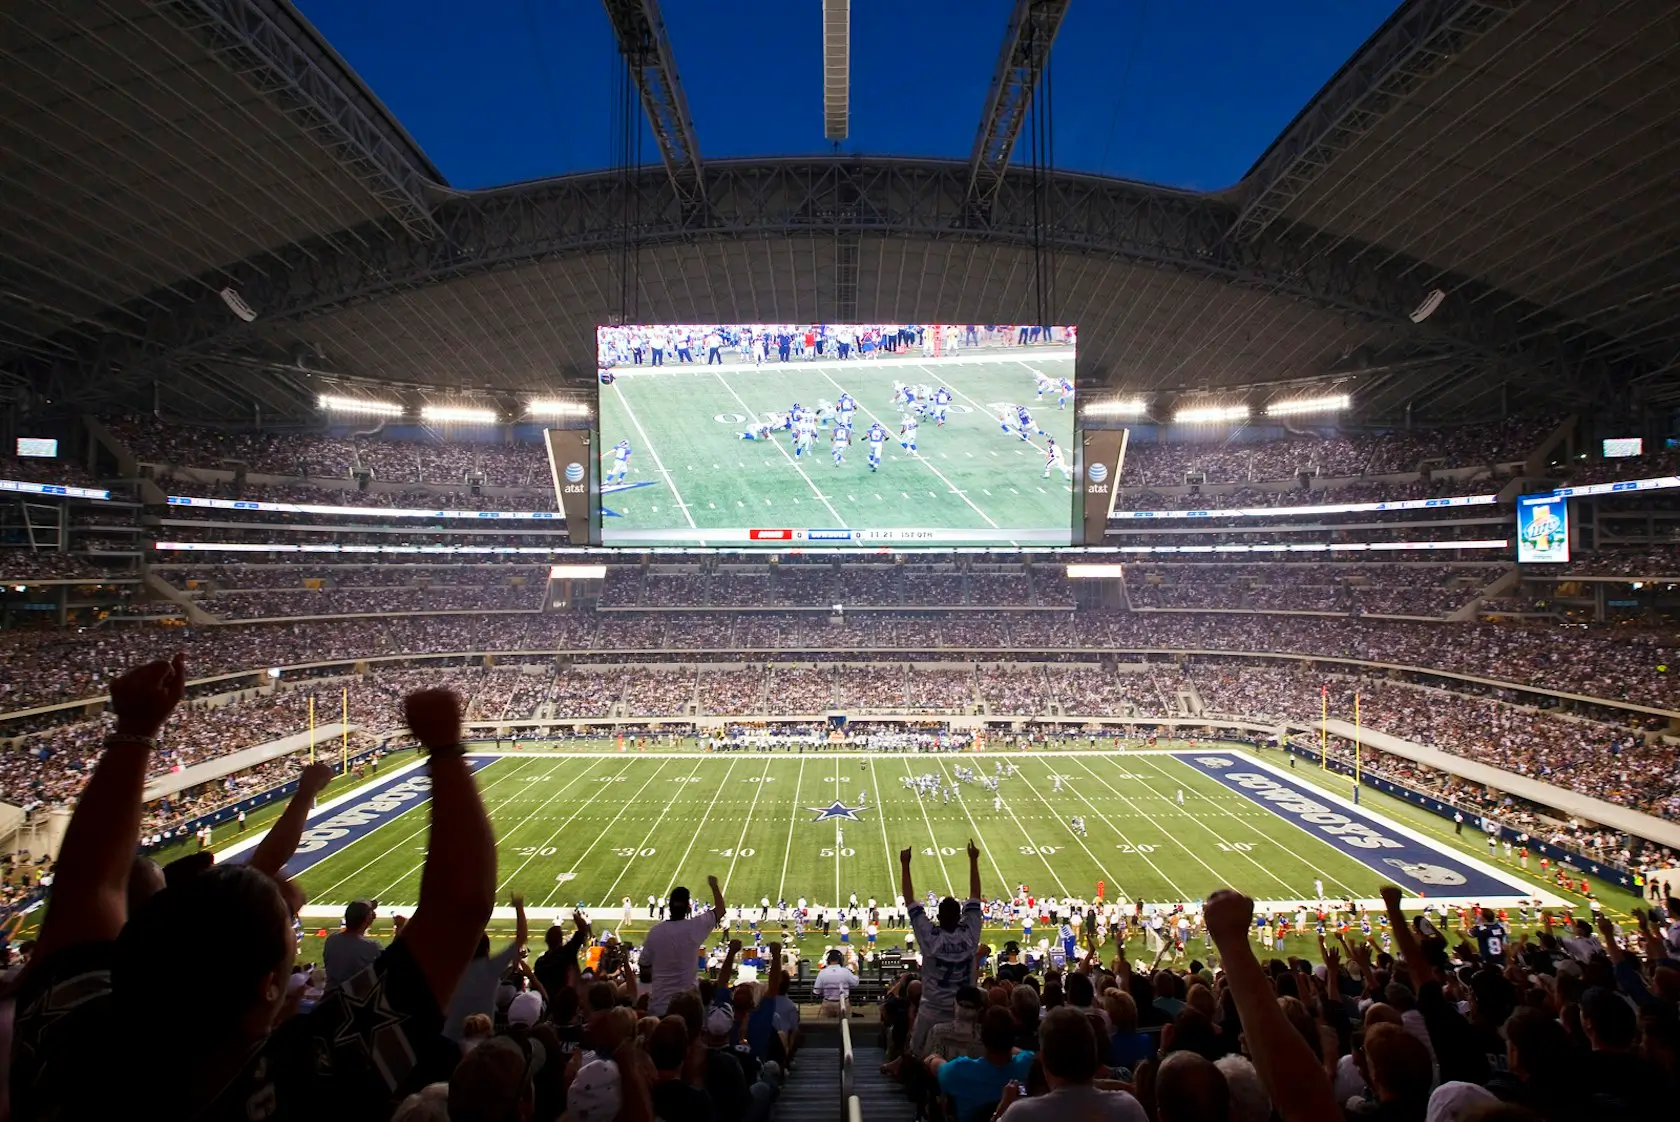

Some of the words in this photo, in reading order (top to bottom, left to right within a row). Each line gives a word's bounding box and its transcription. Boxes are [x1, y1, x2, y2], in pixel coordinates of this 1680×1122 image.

[564, 484, 585, 493] at&t
[1088, 484, 1108, 493] at&t
[1225, 772, 1404, 848] COWBOYS
[518, 846, 557, 857] 20
[617, 847, 656, 857] 30
[719, 847, 756, 857] 40
[819, 847, 856, 857] 50
[921, 846, 957, 856] 40
[1019, 845, 1056, 855] 30
[1116, 844, 1155, 854] 20
[1214, 842, 1253, 852] 10
